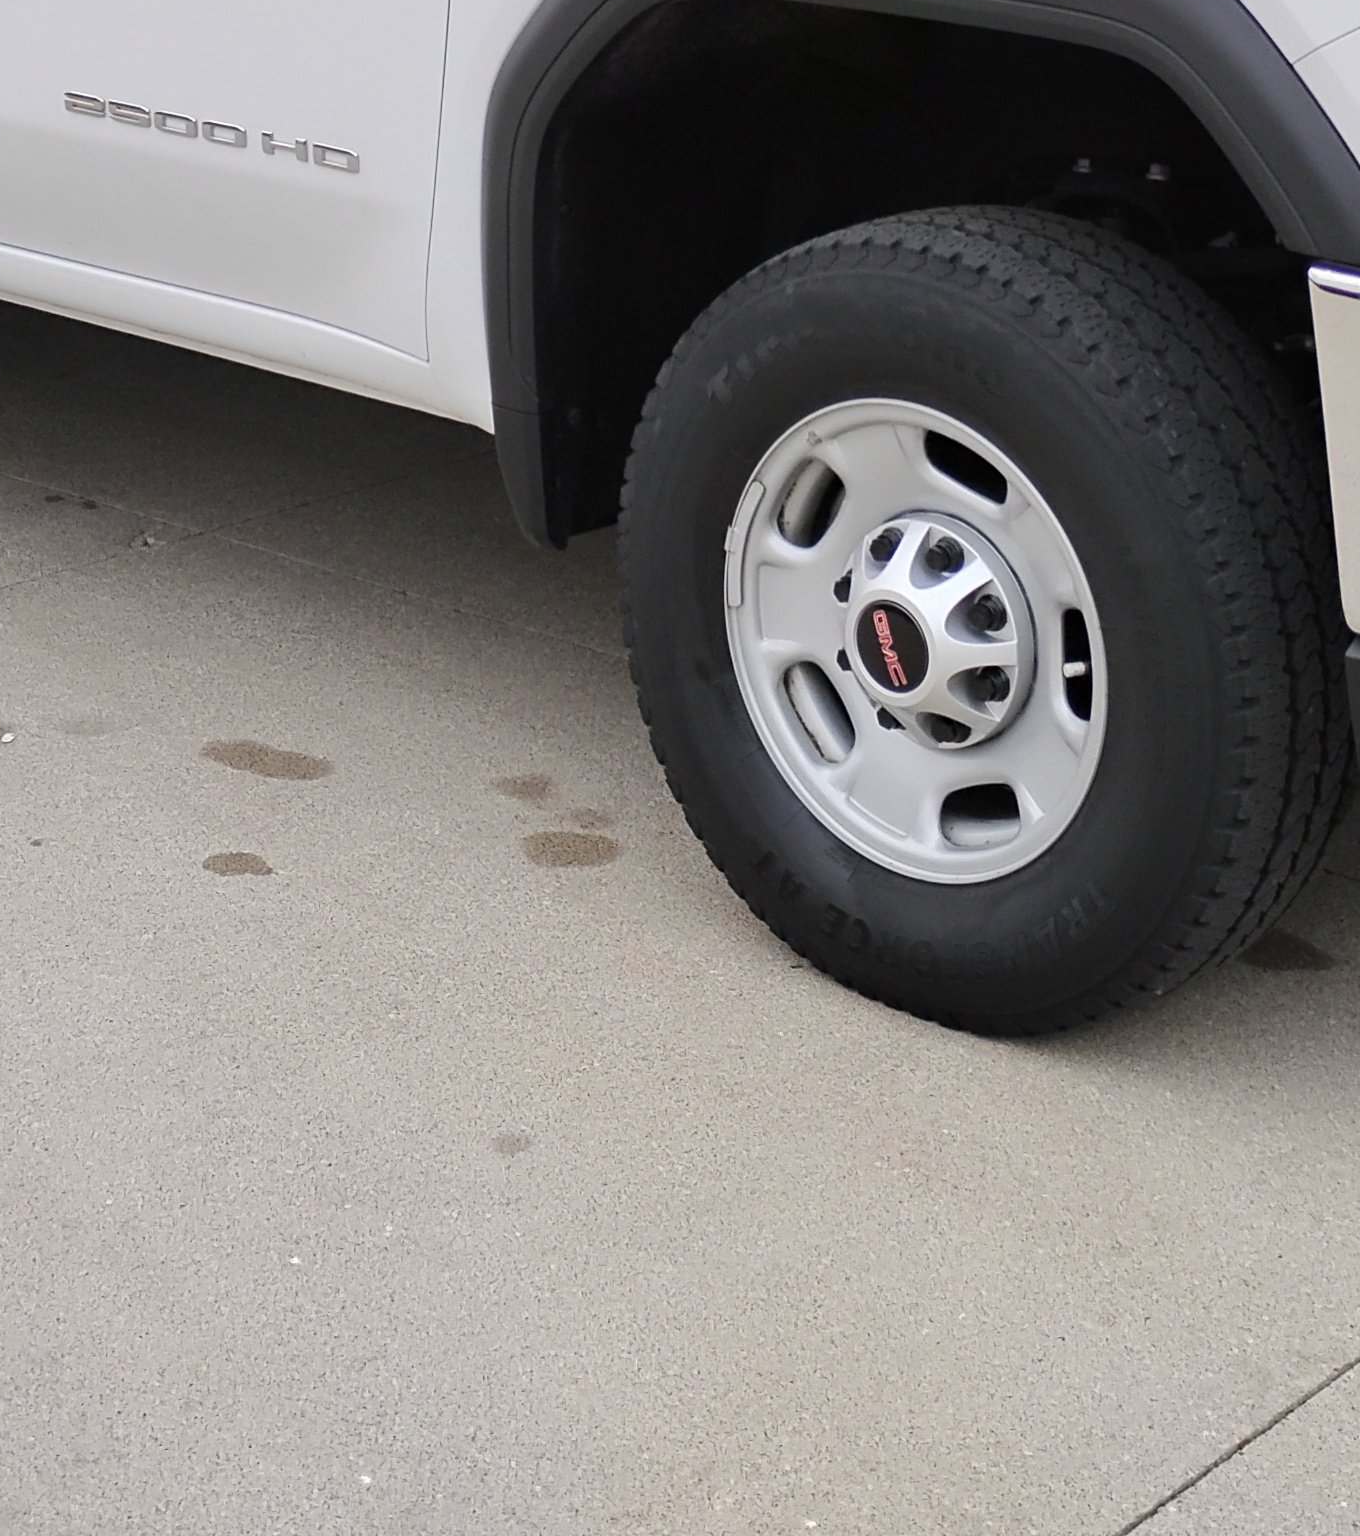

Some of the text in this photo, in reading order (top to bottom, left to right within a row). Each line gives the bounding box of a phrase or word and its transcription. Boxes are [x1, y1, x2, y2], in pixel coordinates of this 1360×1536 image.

[64, 91, 360, 174] 2500 HD
[873, 609, 907, 686] GMC
